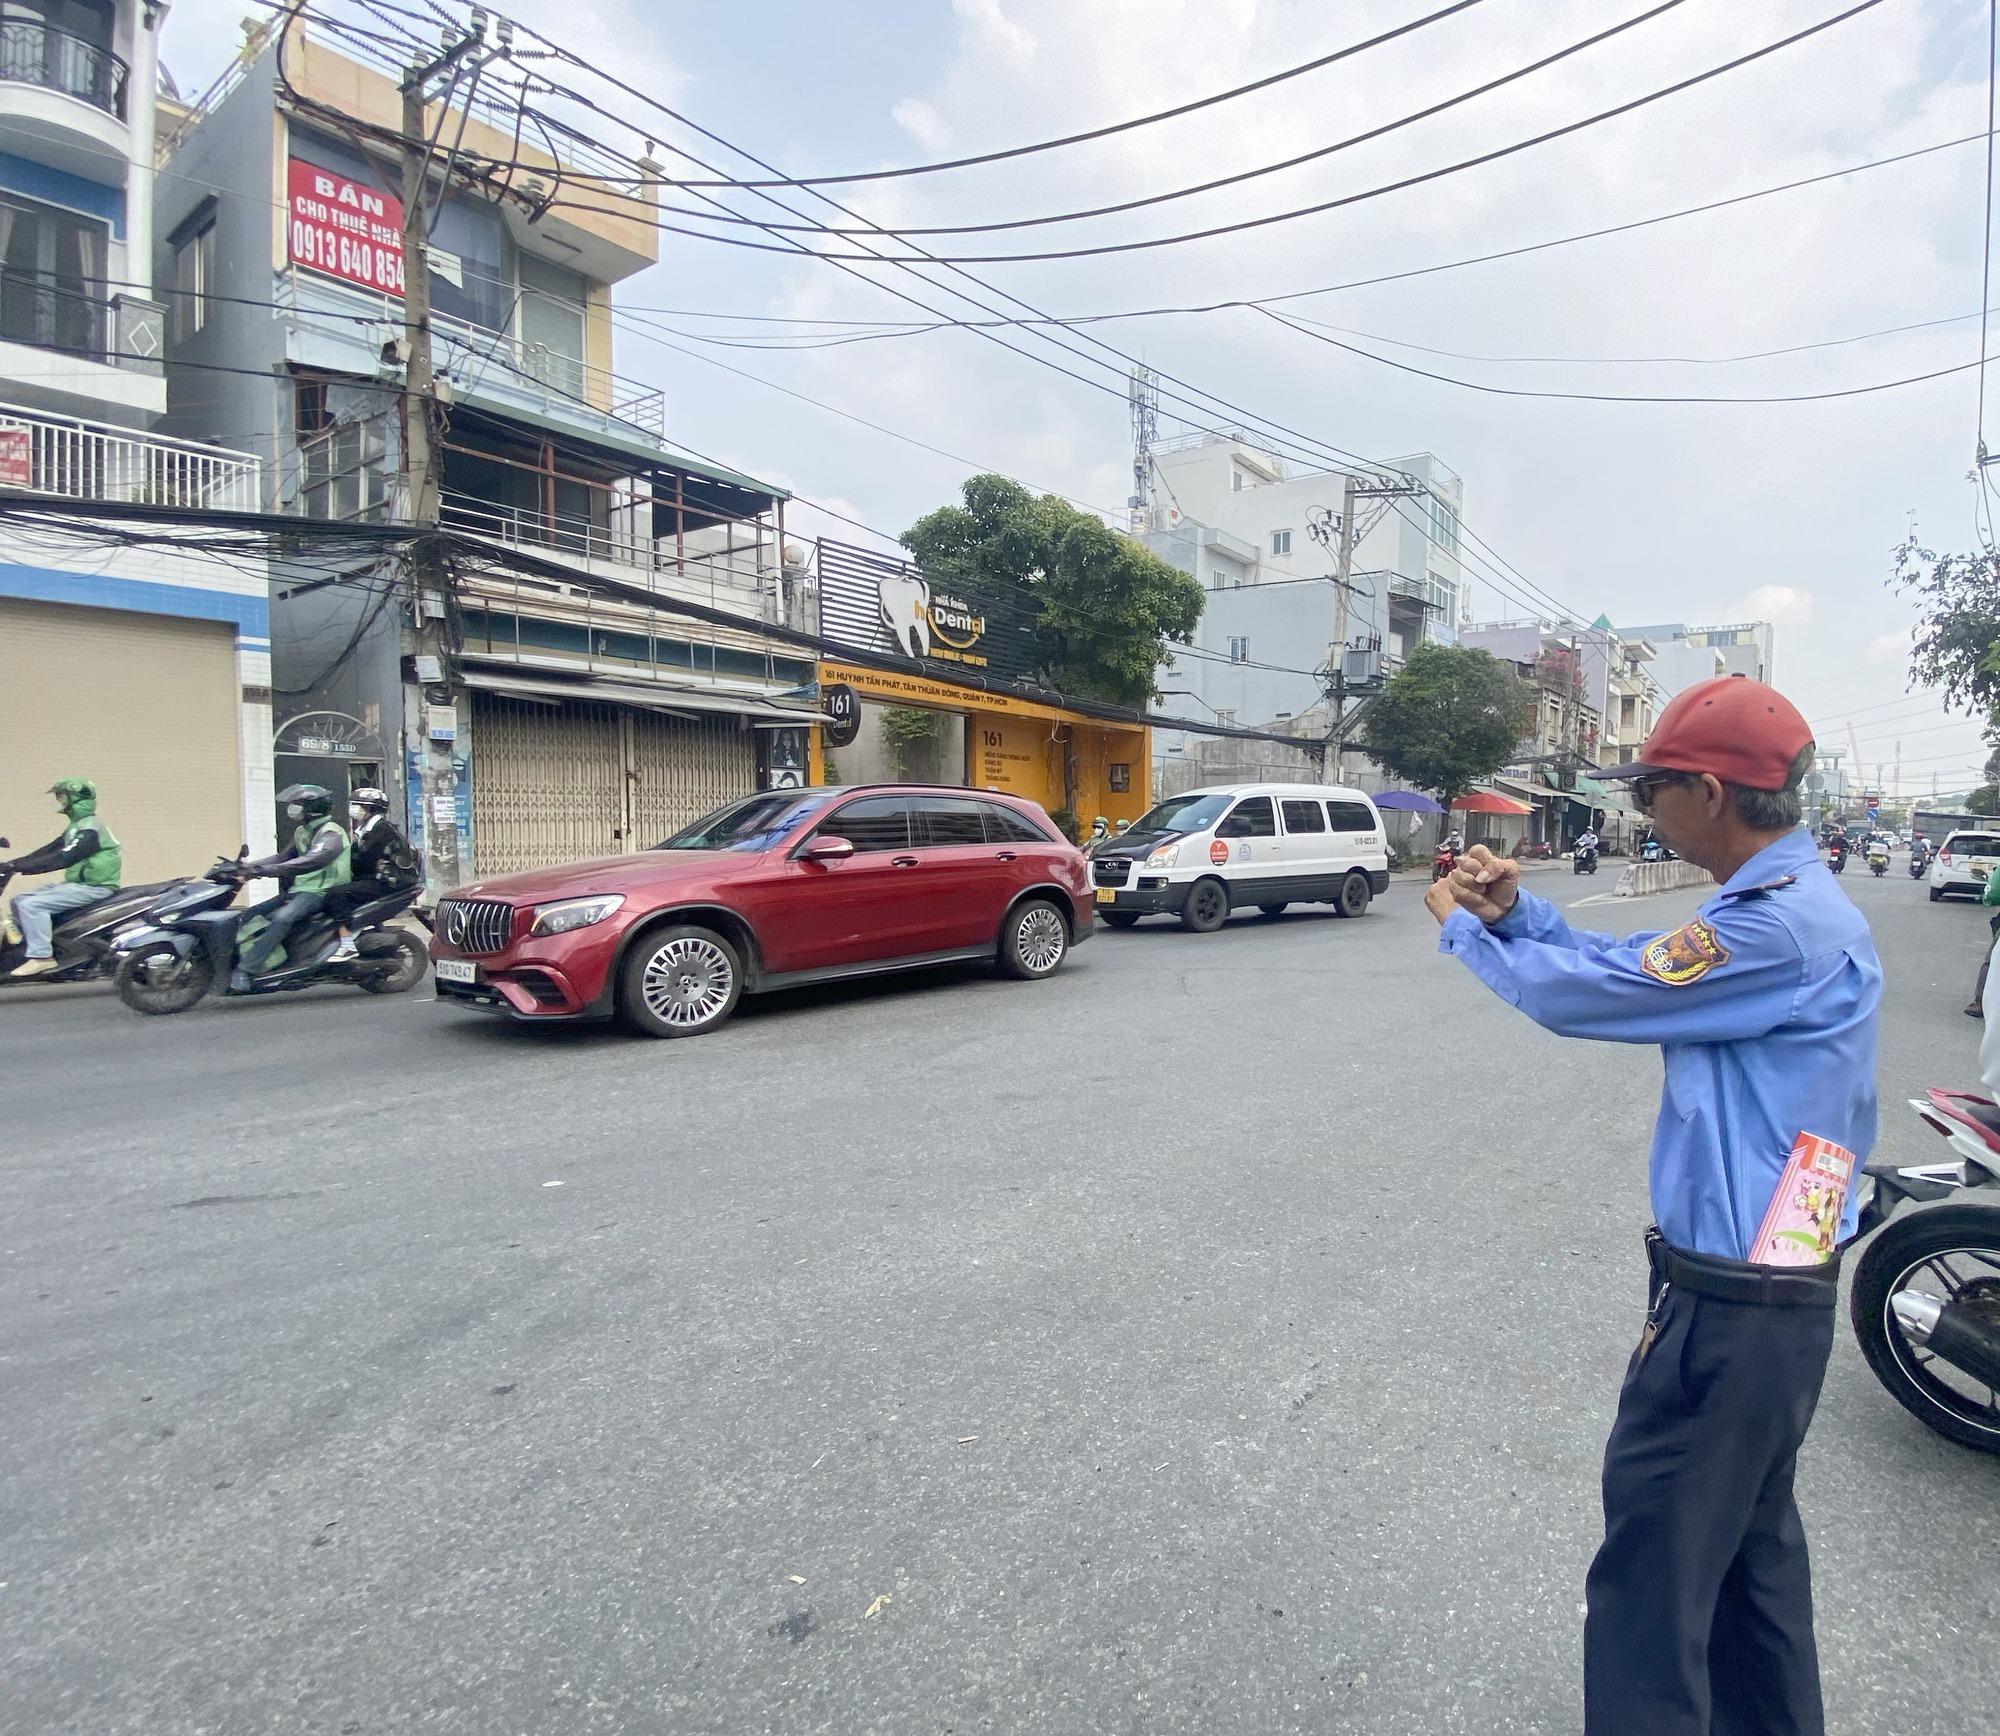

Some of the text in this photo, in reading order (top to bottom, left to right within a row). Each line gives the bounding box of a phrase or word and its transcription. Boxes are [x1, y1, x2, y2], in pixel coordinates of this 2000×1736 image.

[315, 175, 383, 217] BÁN
[296, 195, 402, 250] CHO THUÊ NHÀ
[293, 219, 405, 293] 0913 640 854
[934, 606, 986, 635] Dental
[825, 670, 835, 679] 161
[836, 671, 865, 684] HUỲNH
[865, 675, 881, 687] TẤN
[902, 682, 917, 692] TÂN
[917, 685, 941, 696] THUẬN
[830, 694, 850, 715] 161
[983, 730, 1002, 748] 161
